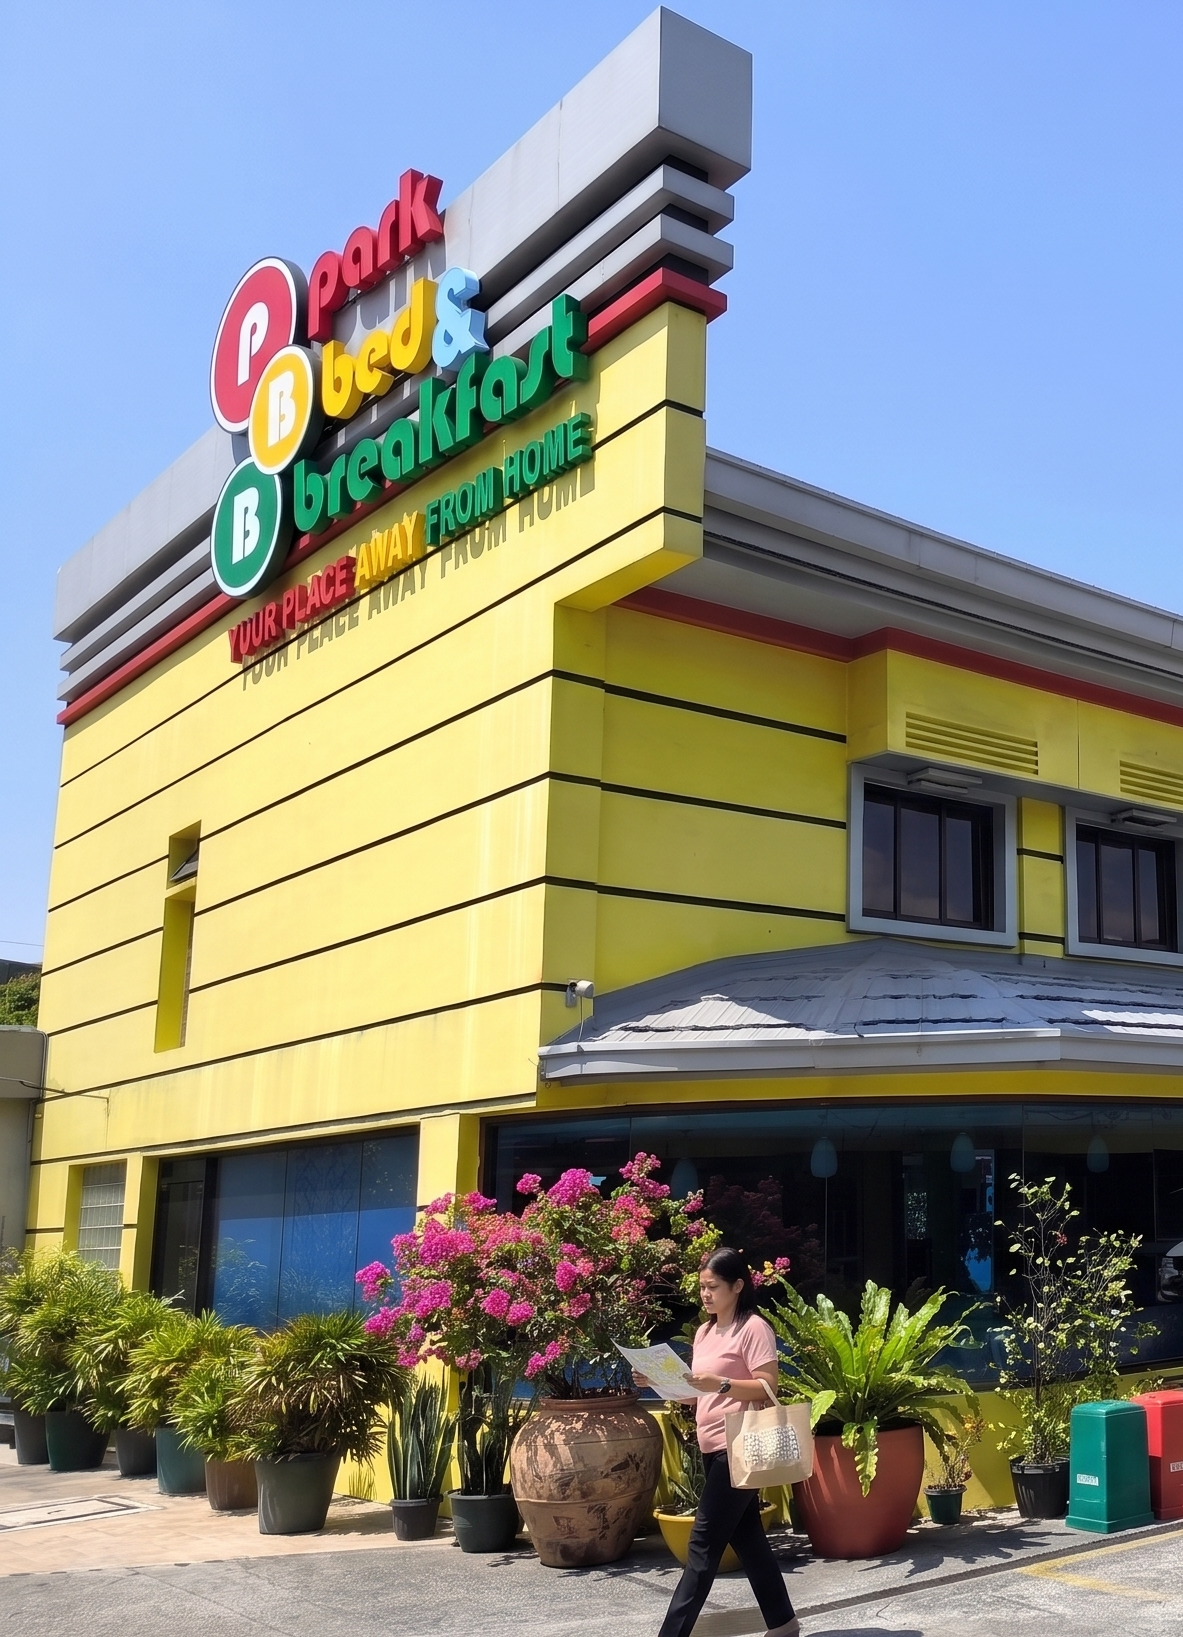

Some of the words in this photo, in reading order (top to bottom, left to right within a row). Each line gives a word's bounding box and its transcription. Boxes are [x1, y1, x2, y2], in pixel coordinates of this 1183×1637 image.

[308, 168, 444, 342] park
[237, 301, 269, 387] P
[267, 370, 296, 448] B
[294, 294, 588, 534] breakfast
[322, 278, 438, 419] bed
[432, 266, 489, 371] &
[231, 487, 260, 565] B
[282, 556, 355, 630] PLACE
[354, 510, 425, 589] AWAY
[426, 467, 501, 547] FROM
[504, 412, 592, 499] HOME
